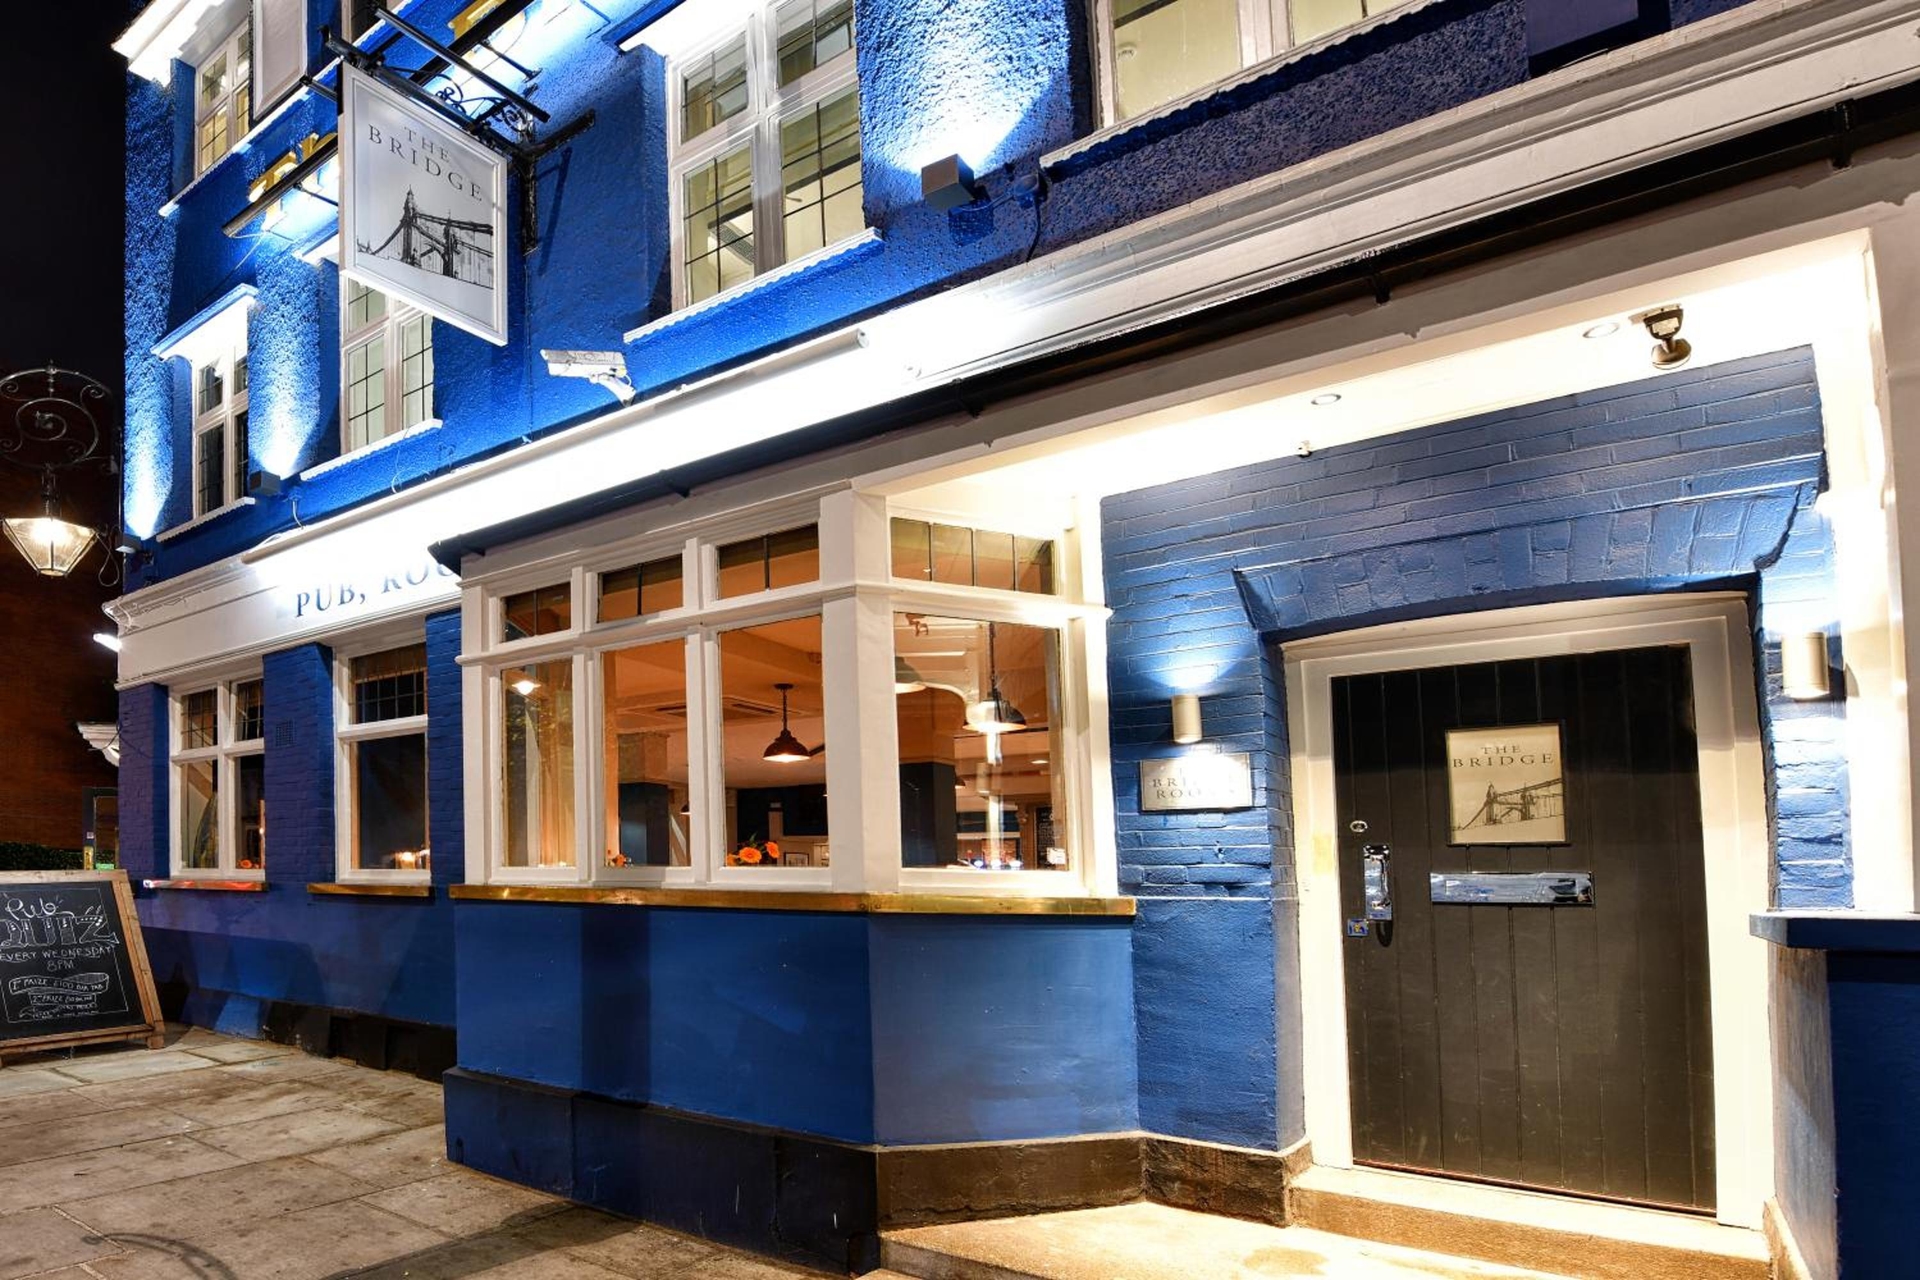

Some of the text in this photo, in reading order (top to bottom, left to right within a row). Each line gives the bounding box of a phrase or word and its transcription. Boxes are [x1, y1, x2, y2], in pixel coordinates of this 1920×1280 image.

[404, 125, 452, 163] THE
[368, 123, 483, 203] BRIDGE
[296, 582, 366, 618] PUB,
[1452, 753, 1555, 768] BRIDGE
[1481, 744, 1523, 755] THE
[5, 898, 56, 920] Pub
[0, 946, 114, 962] EVERY WEDNESDAY
